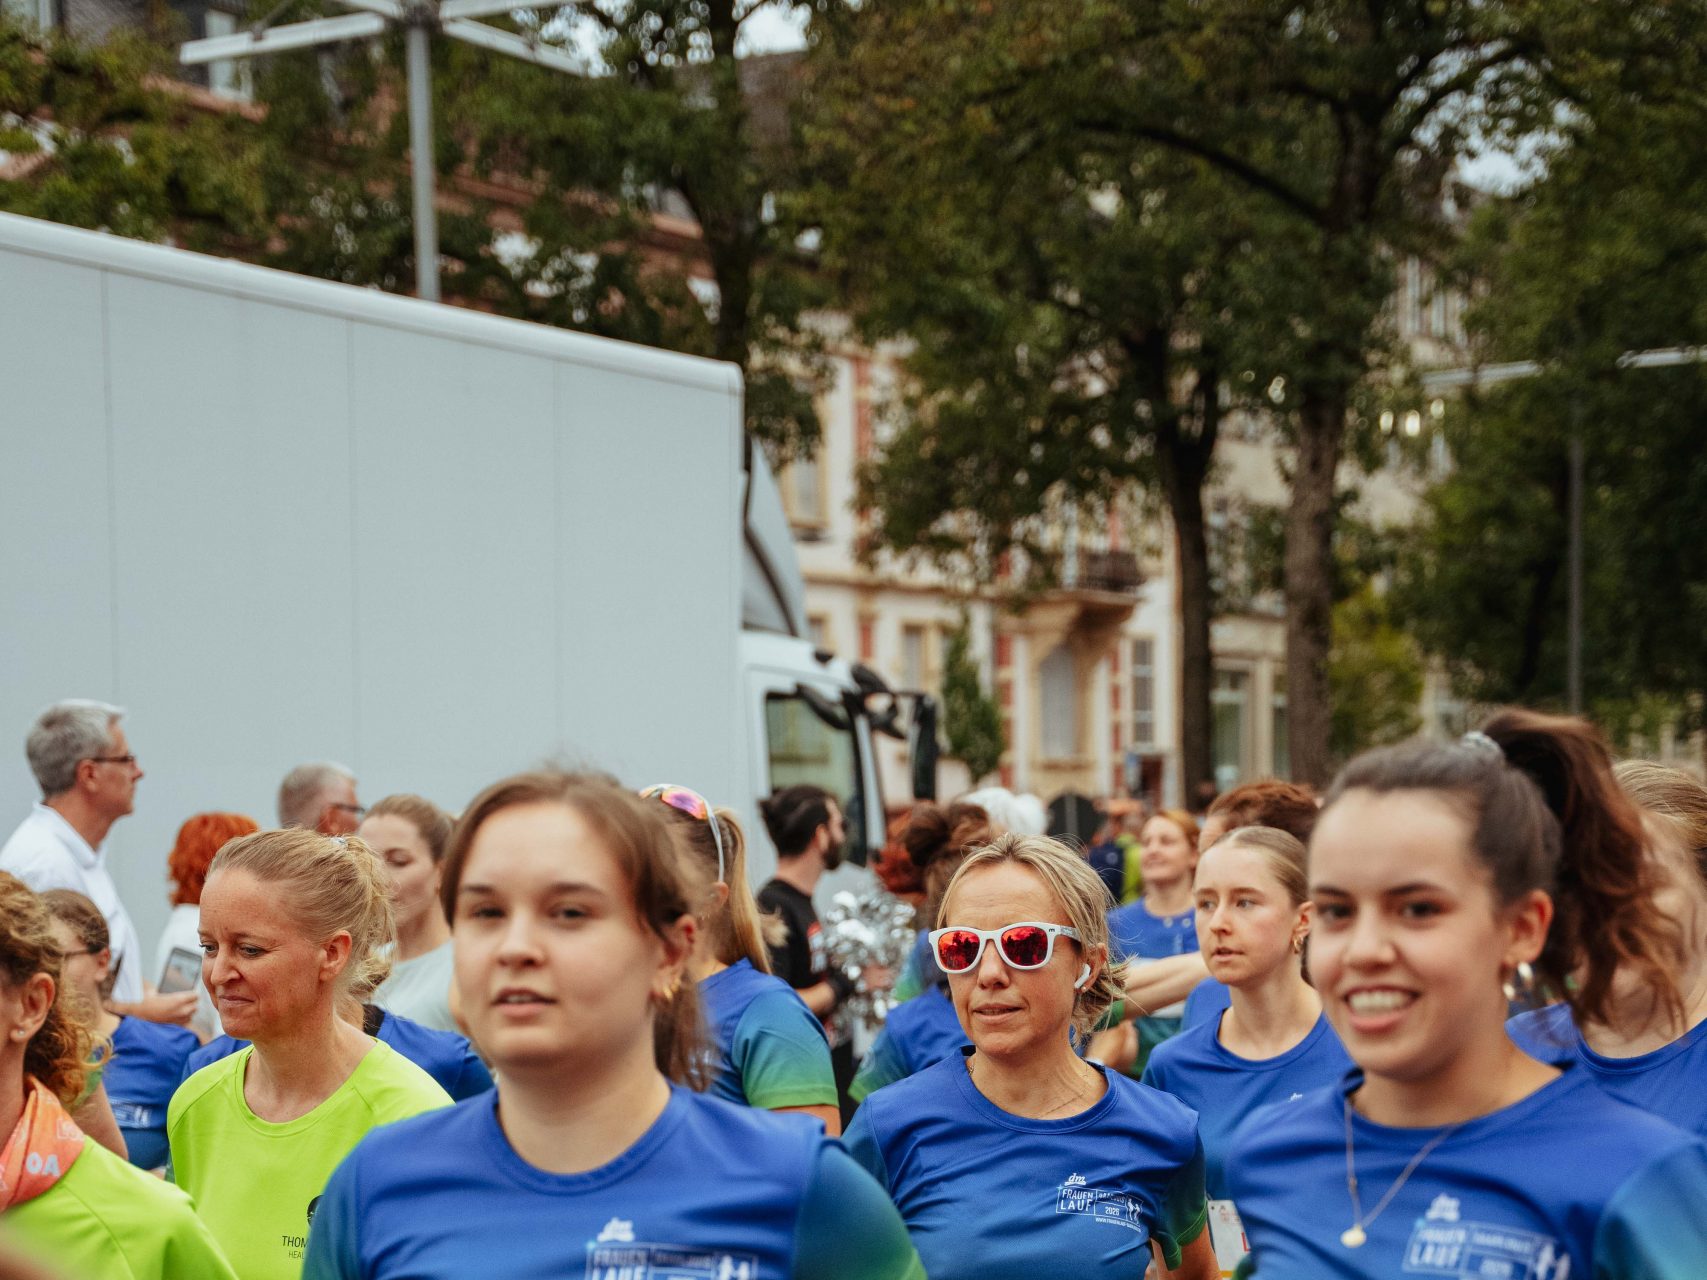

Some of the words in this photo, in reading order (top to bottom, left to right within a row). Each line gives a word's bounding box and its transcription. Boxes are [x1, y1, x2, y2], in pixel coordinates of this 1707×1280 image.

[1062, 1188, 1094, 1200] FRAUEN
[1060, 1199, 1092, 1212] LAUF
[1105, 1206, 1120, 1216] 2026
